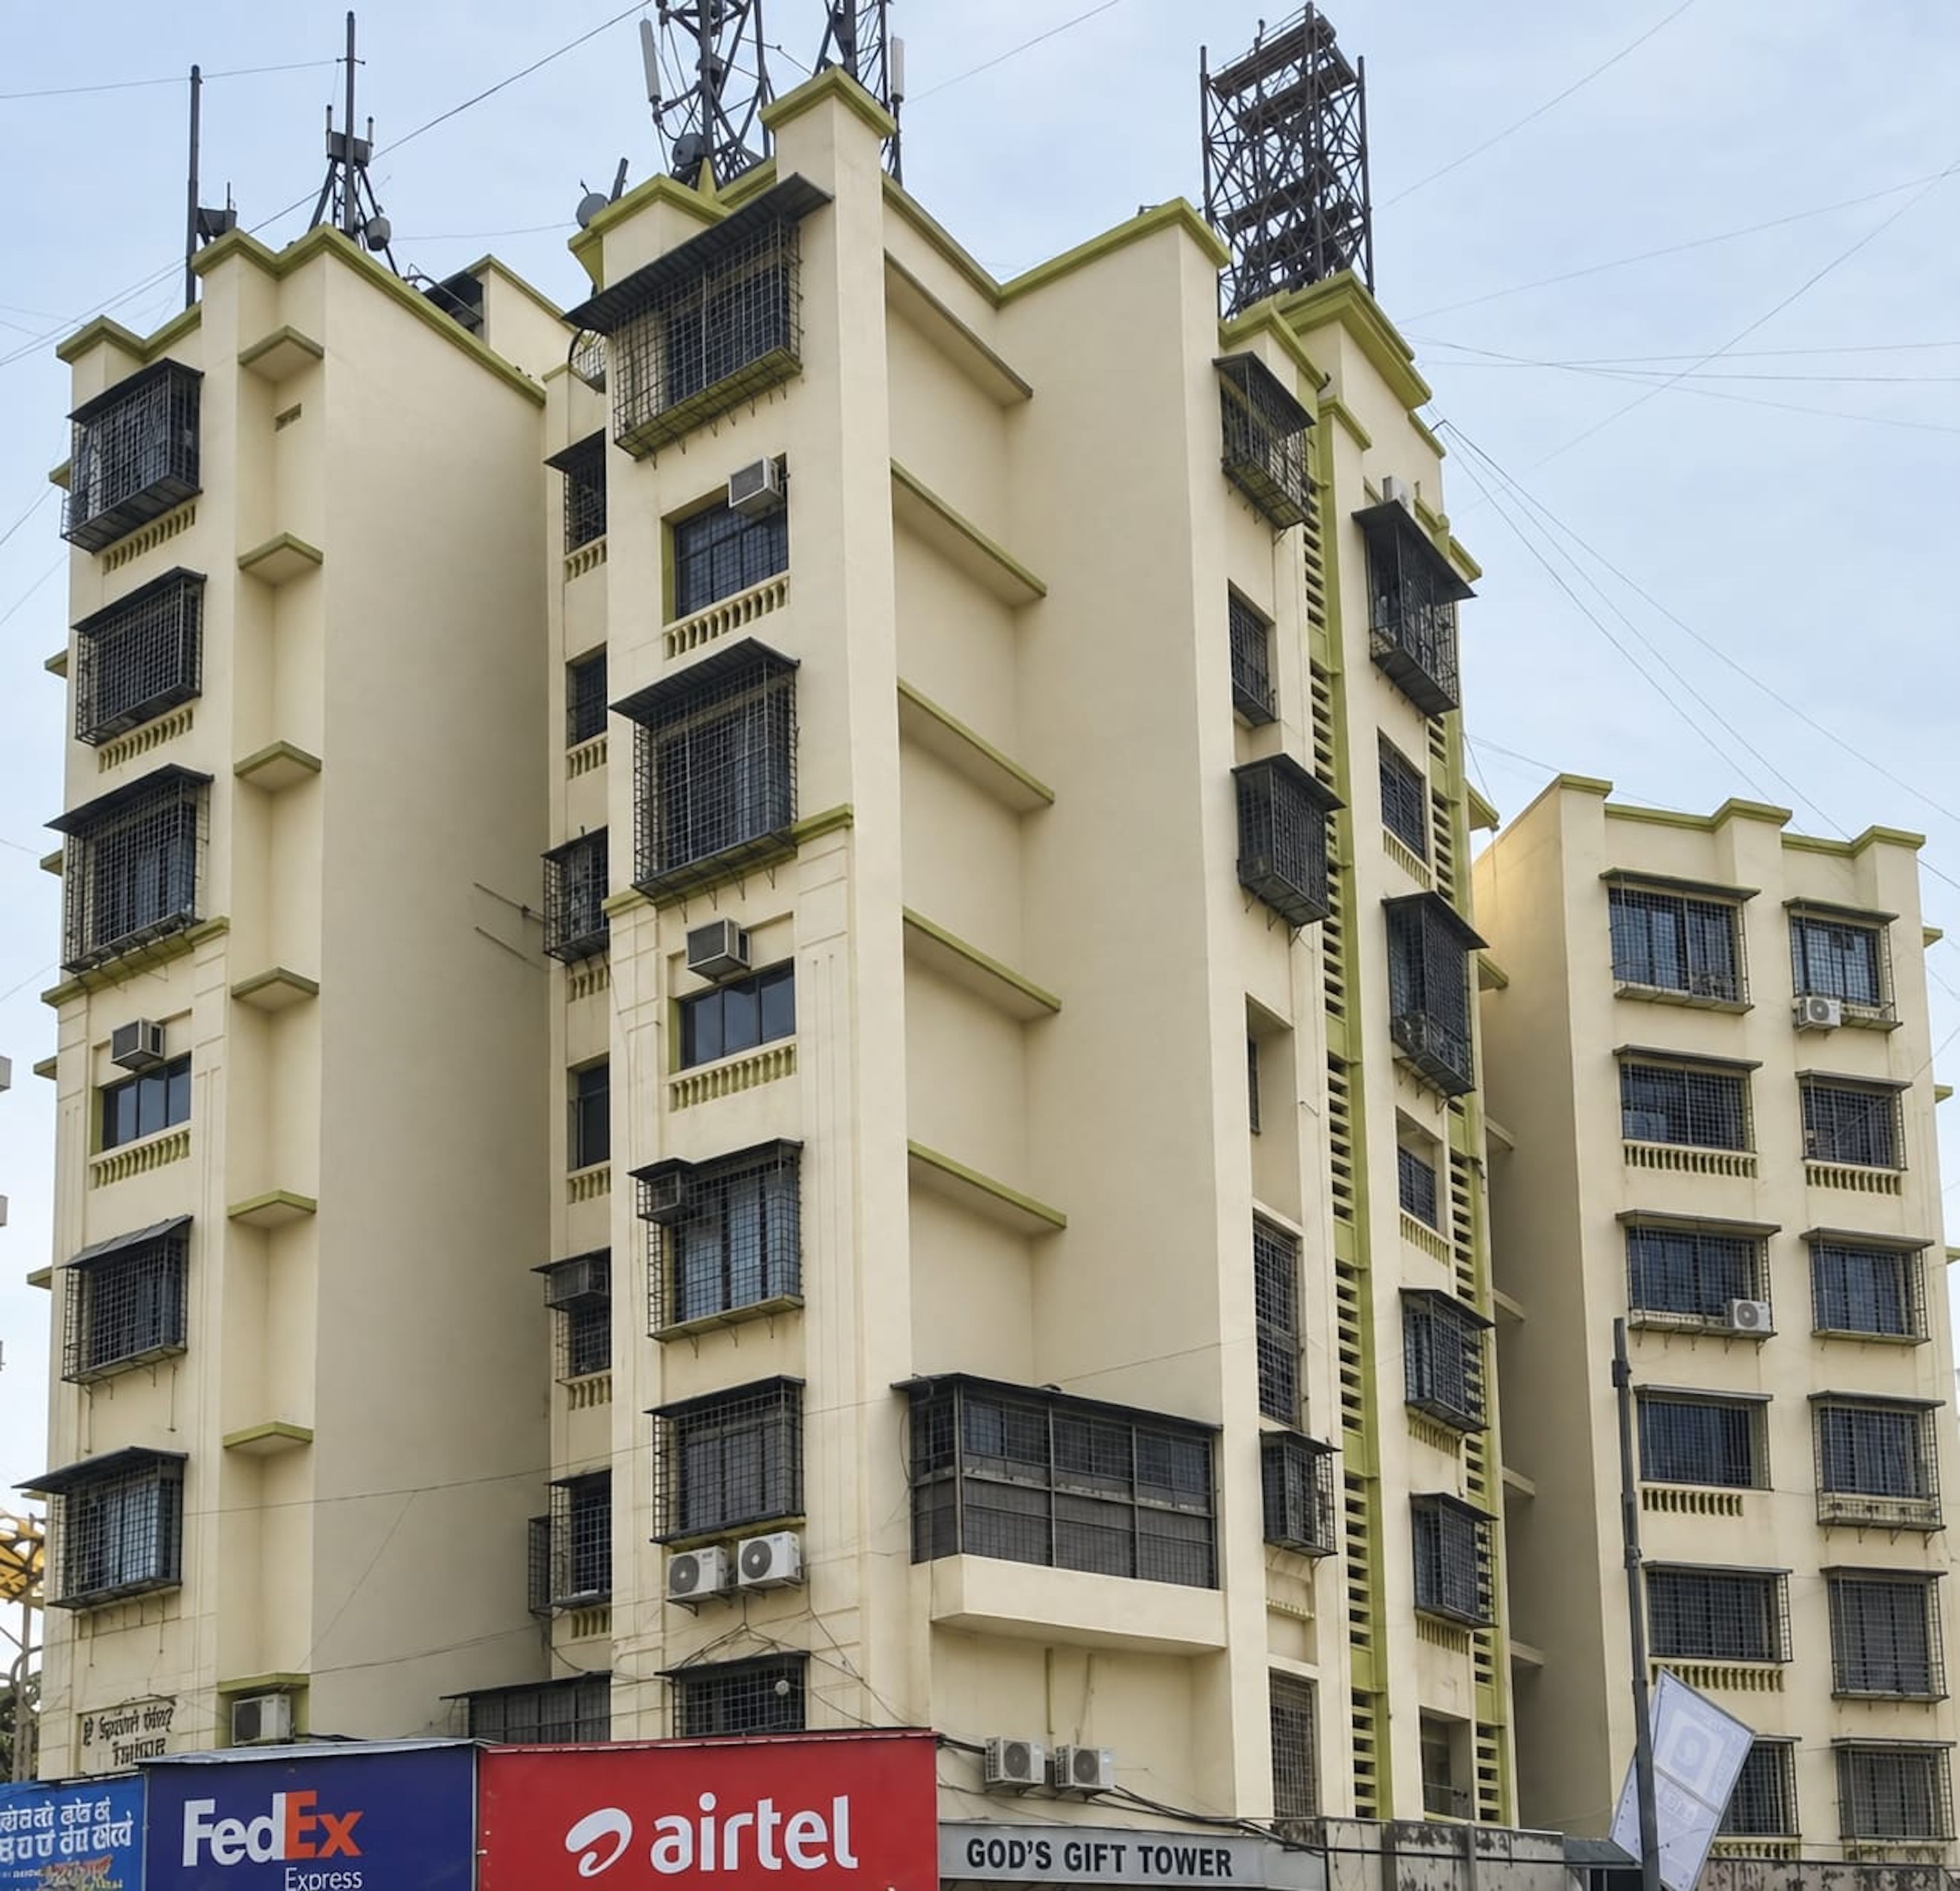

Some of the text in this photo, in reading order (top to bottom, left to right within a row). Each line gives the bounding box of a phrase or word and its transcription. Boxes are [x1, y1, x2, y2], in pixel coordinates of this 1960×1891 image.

[182, 1789, 364, 1867] FedEx
[650, 1791, 860, 1875] airtel
[284, 1867, 363, 1891] Express
[967, 1838, 1233, 1877] GOD'S GIFT TOWER
